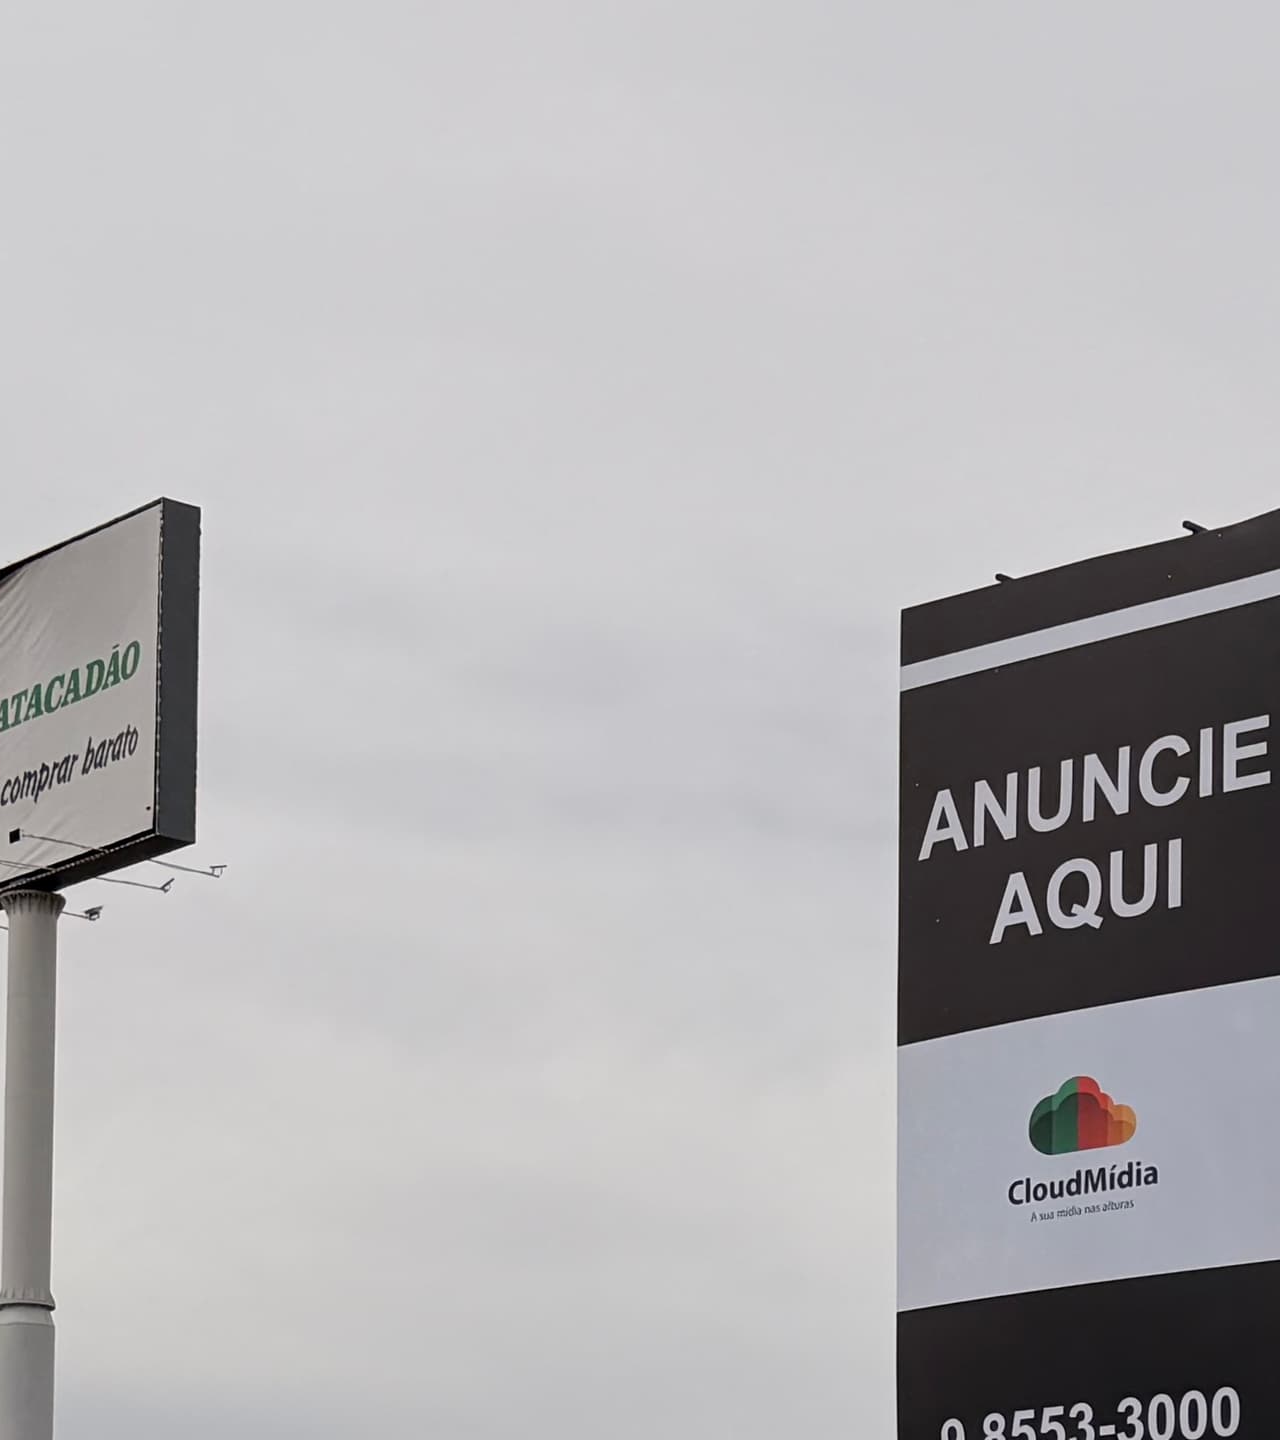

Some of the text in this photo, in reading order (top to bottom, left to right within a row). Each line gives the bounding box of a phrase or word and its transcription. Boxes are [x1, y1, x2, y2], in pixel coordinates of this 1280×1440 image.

[0, 753, 79, 807] comprar
[81, 724, 139, 776] barato
[918, 714, 1271, 862] ANUNCIE
[989, 838, 1182, 945] AQUI
[1008, 1161, 1158, 1206] CloudMídia
[1030, 1212, 1037, 1223] A
[1084, 1204, 1100, 1214] nas
